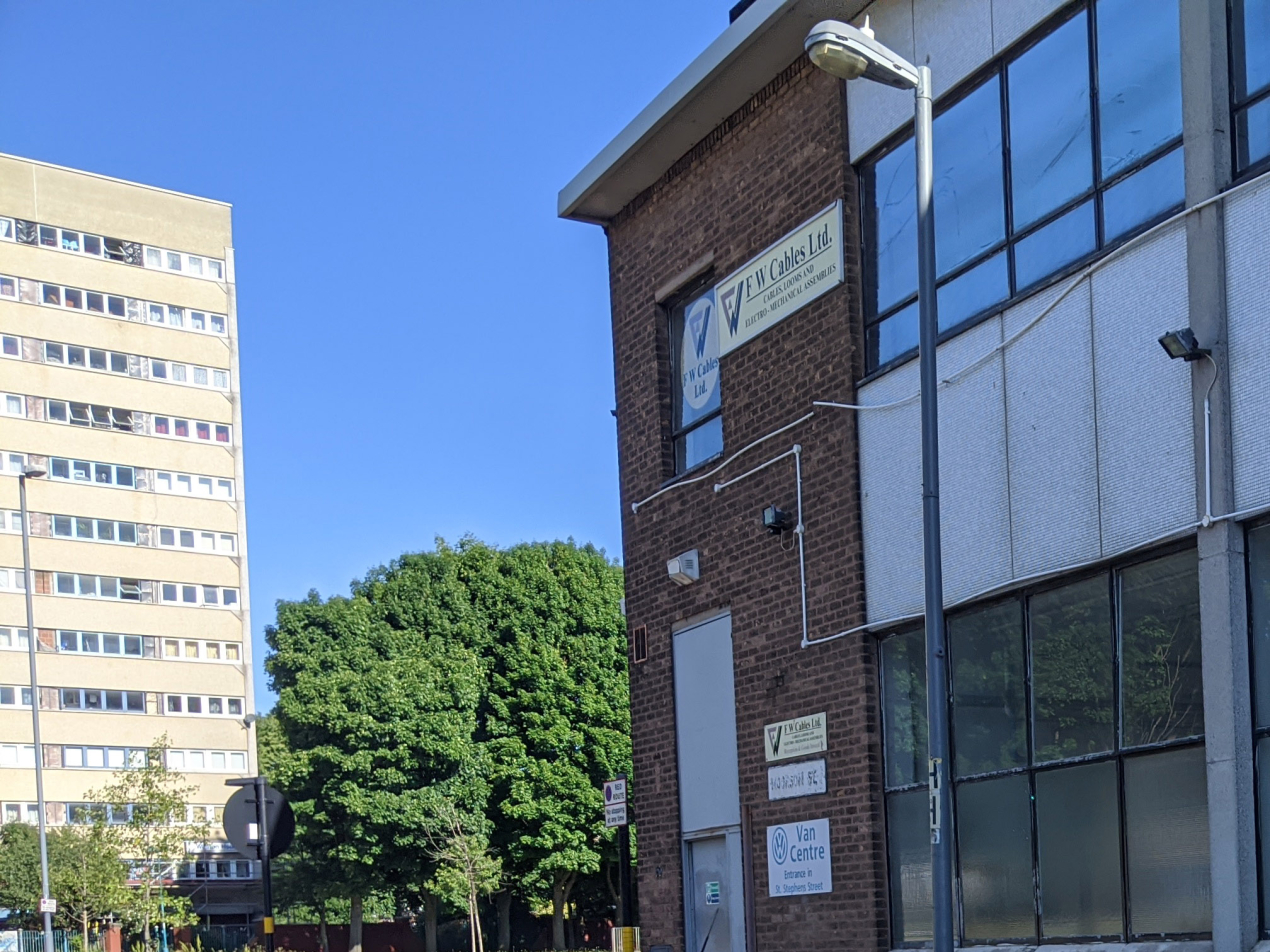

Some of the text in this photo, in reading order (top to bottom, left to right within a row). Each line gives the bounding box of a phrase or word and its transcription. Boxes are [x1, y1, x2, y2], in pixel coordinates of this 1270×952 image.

[746, 223, 832, 299] F W Cables Ltd.
[763, 264, 814, 304] CABLES, LOOMS AND
[745, 308, 768, 328] ELECTRO
[770, 287, 802, 312] MECHANICAL
[804, 262, 836, 290] ASSEMBLIES
[683, 356, 719, 387] F W Cables
[694, 380, 708, 398] Ltd.
[788, 722, 794, 732] W
[795, 720, 810, 732] Cables
[796, 824, 816, 842] Van
[790, 844, 824, 862] Centre
[784, 868, 812, 880] Entrance in
[808, 882, 824, 892] Street
